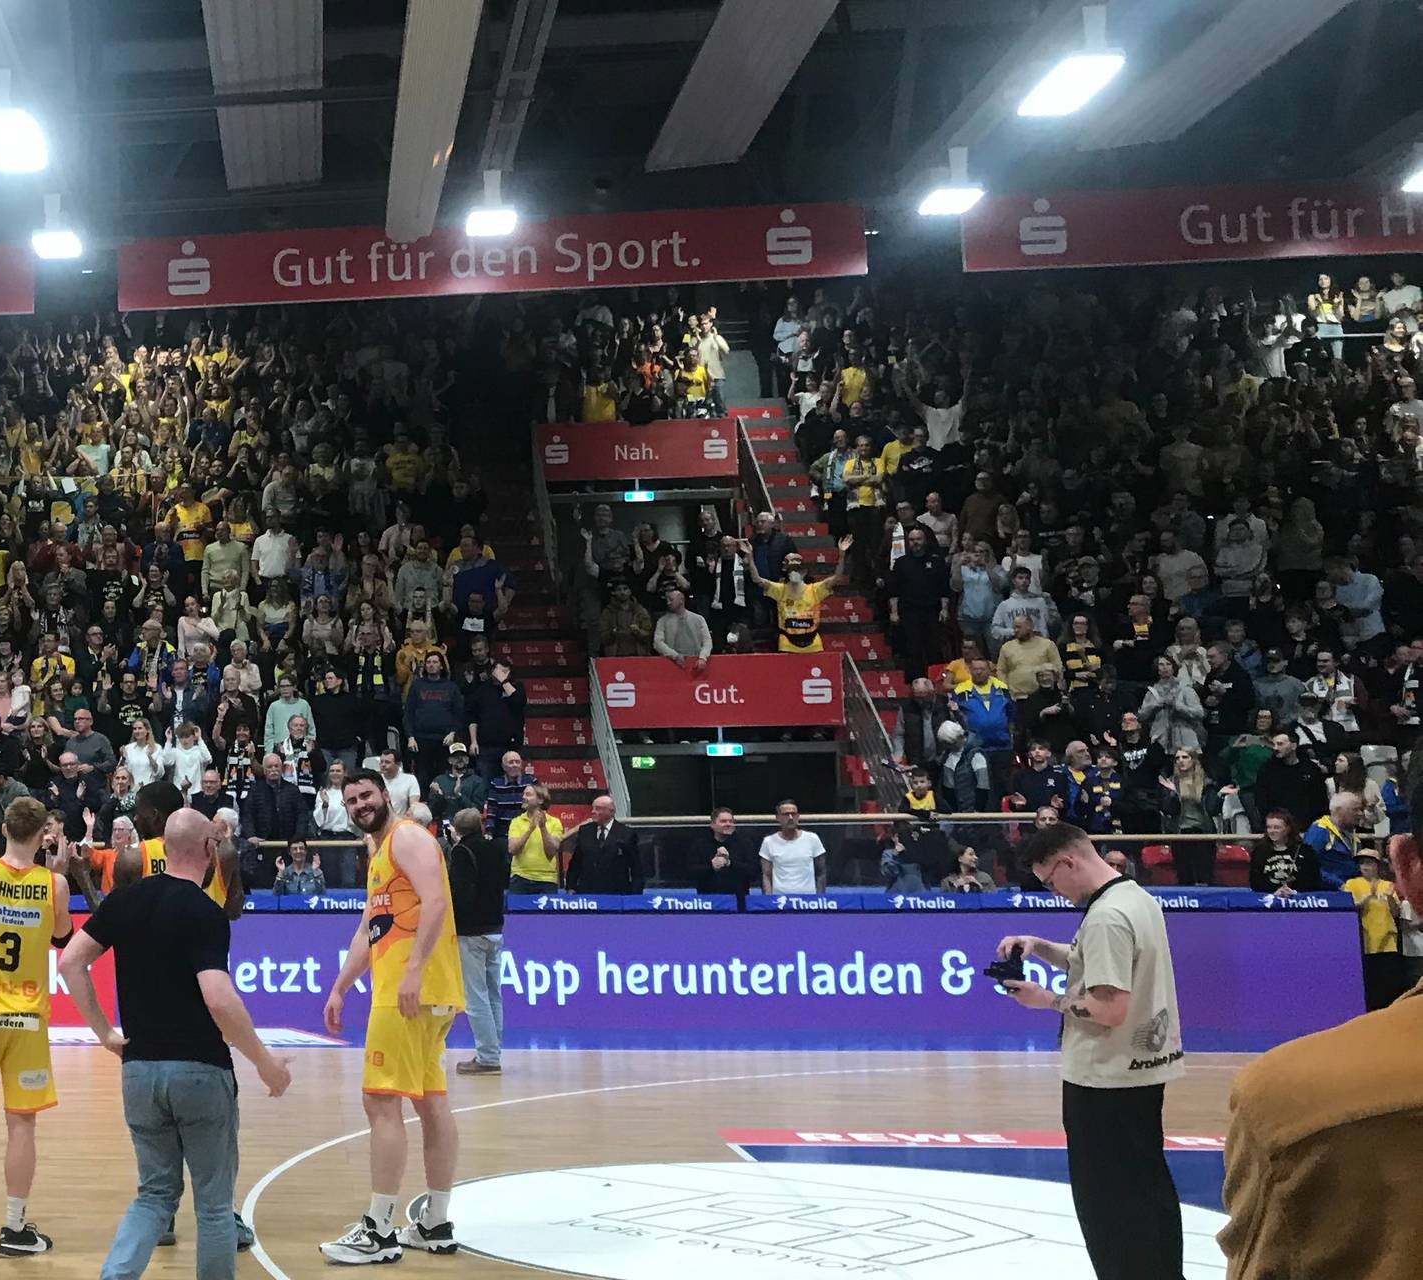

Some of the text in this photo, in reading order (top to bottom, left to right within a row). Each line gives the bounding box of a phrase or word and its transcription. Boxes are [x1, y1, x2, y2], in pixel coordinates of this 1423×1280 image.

[1180, 204, 1274, 246] Gut
[1287, 197, 1365, 241] für
[272, 246, 355, 289] Gut
[368, 240, 432, 282] für
[450, 240, 537, 280] den
[555, 230, 702, 284] Sport.
[614, 442, 660, 461] Nah.
[694, 683, 745, 704] Gut.
[321, 897, 367, 910] Thalia
[550, 898, 598, 910] Thalia
[665, 898, 713, 911] Thalia
[789, 897, 838, 910] Thalia
[905, 897, 956, 910] Thalia
[1278, 895, 1329, 909] Thalia
[228, 956, 322, 994] etzt
[499, 951, 580, 1006] App
[597, 951, 923, 996] herunterladen
[940, 949, 975, 996] &
[795, 1132, 1018, 1145] REWE
